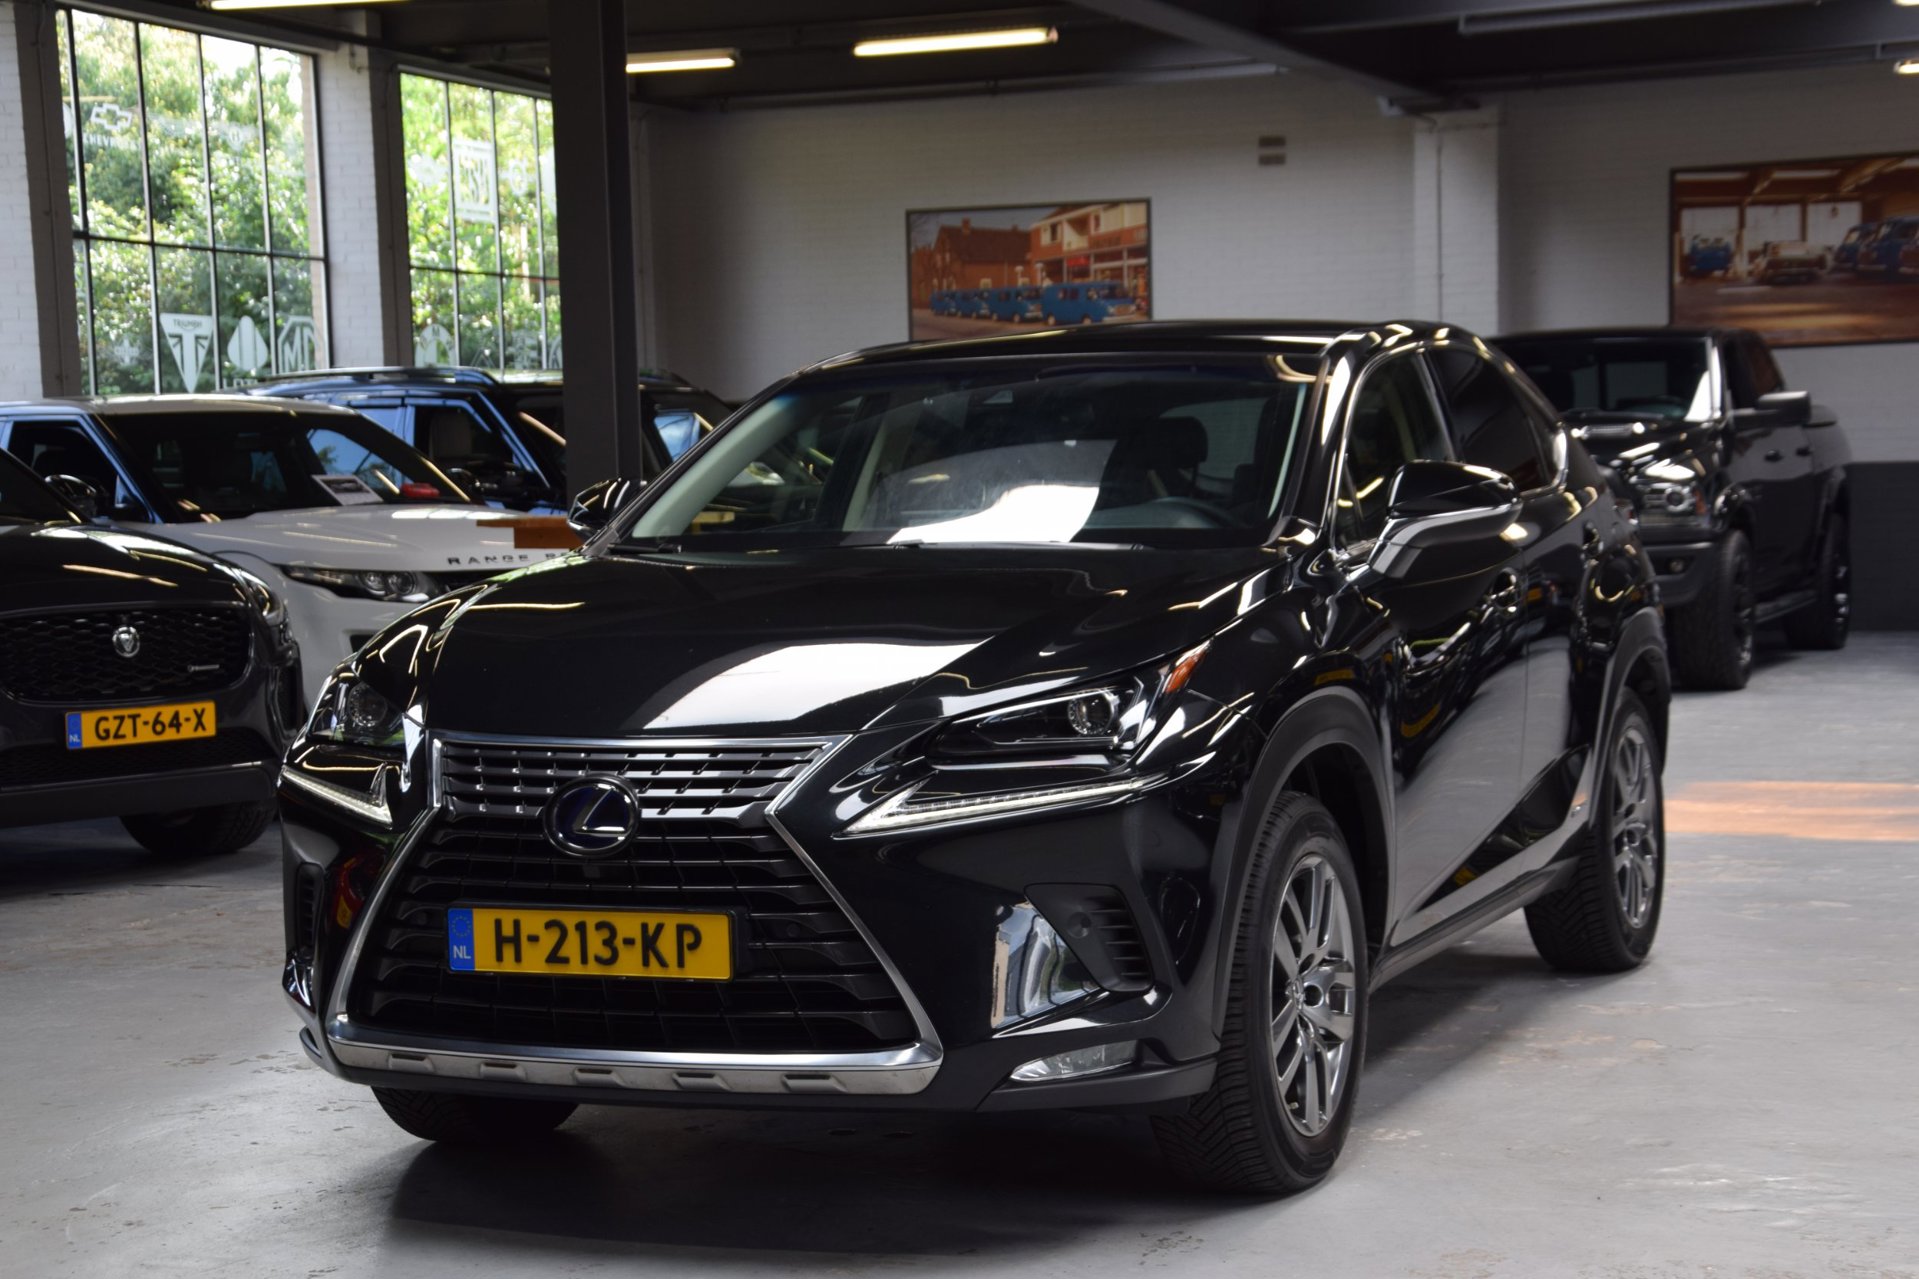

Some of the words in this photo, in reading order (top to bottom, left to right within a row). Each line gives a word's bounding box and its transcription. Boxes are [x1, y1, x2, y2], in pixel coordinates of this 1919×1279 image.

[447, 554, 529, 566] RANGE
[69, 735, 81, 743] NL
[94, 708, 207, 741] GZT-64-X
[453, 945, 471, 960] NL
[494, 918, 702, 969] H-213-KP
